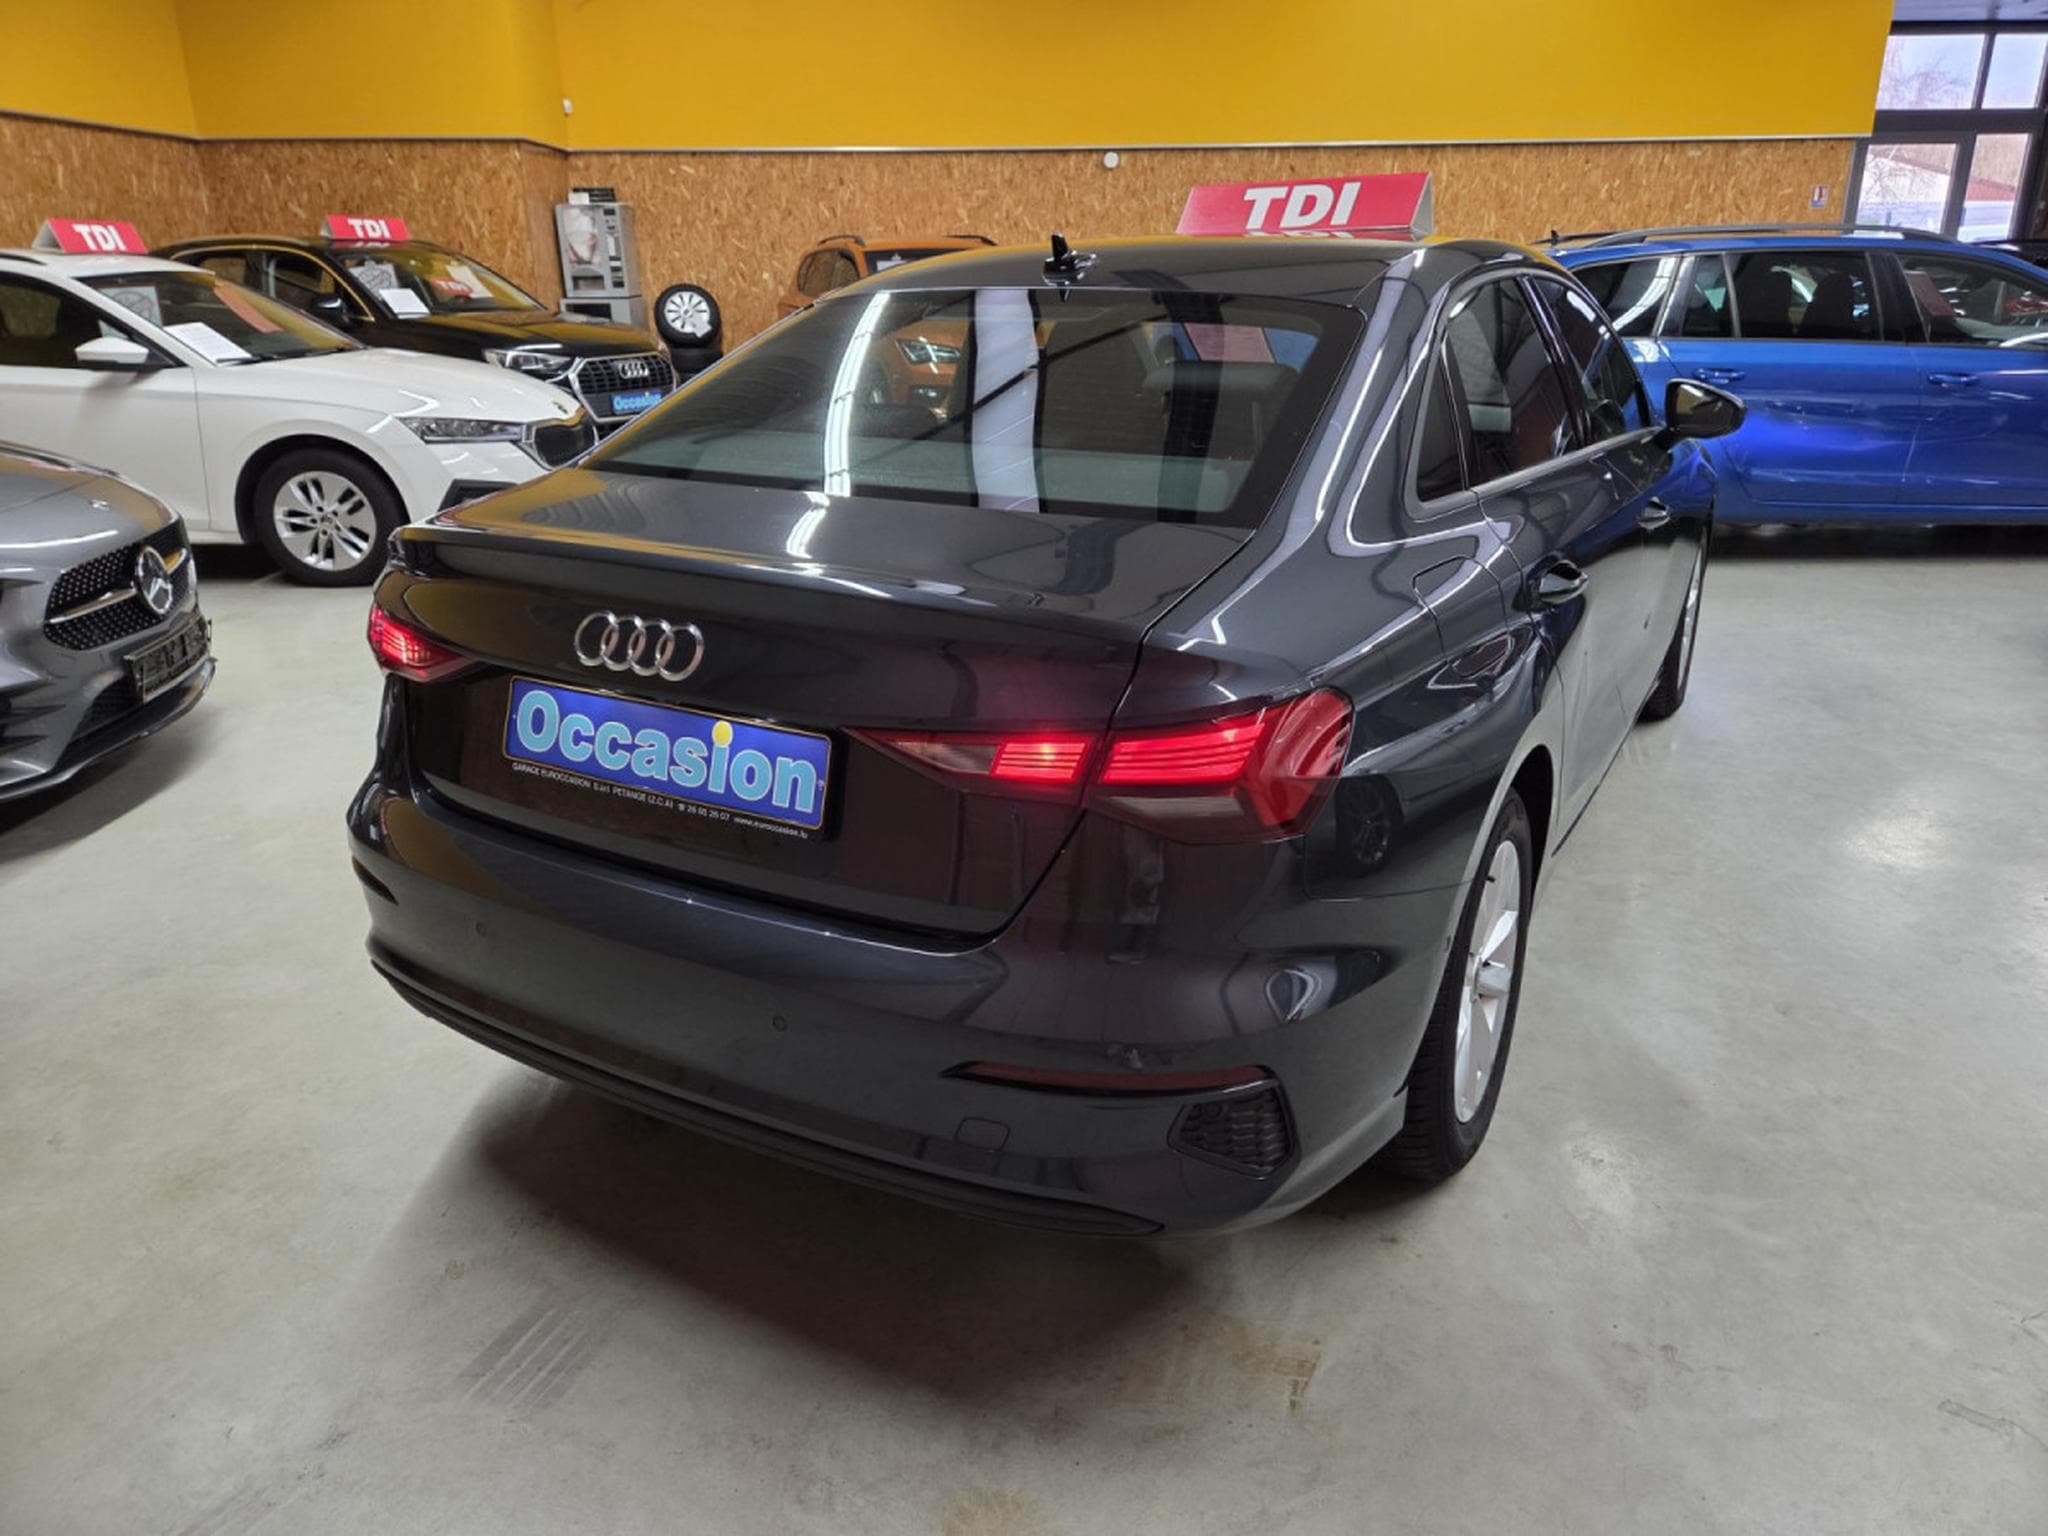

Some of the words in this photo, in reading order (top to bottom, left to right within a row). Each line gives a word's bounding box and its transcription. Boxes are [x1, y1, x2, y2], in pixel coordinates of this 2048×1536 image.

[1243, 181, 1362, 230] TDI
[71, 223, 127, 251] TDI
[347, 218, 392, 239] TDI
[516, 689, 817, 814] Occasion
